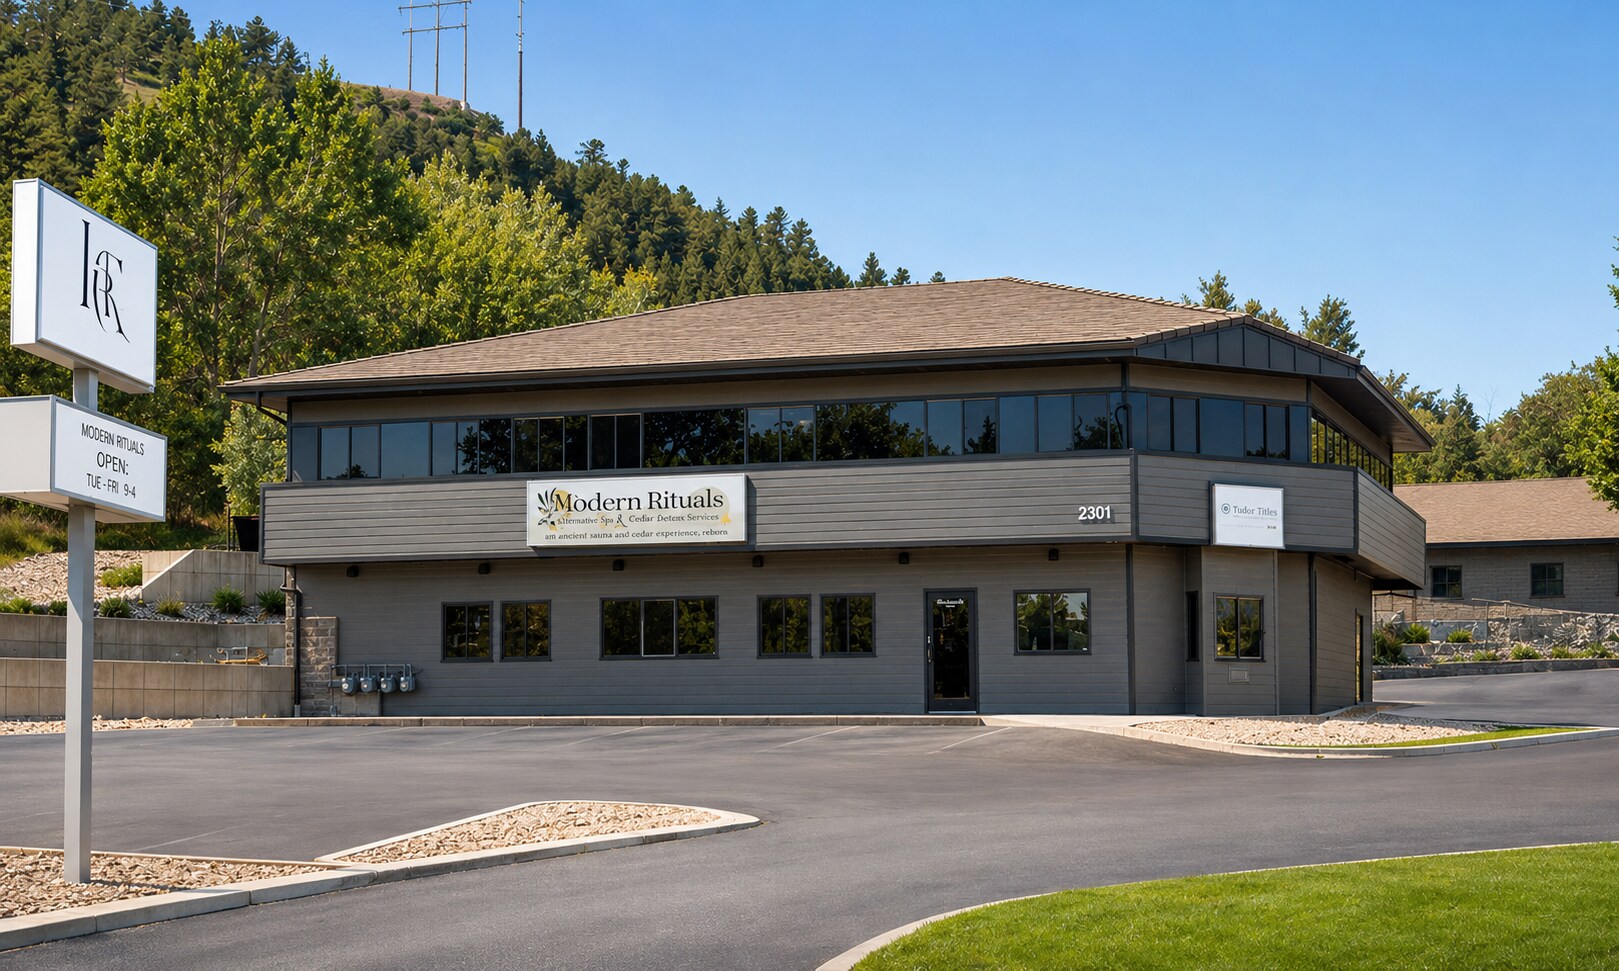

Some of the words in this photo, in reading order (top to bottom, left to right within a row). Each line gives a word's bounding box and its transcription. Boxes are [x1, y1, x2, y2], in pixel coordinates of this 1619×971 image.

[81, 422, 114, 446] MODERN
[116, 434, 144, 456] RITUALS
[96, 451, 129, 476] OPEN:
[86, 472, 101, 490] TUE
[107, 478, 118, 494] FRI
[123, 483, 136, 499] 9-4
[648, 488, 724, 510] Rituals
[1078, 505, 1111, 520] 2301
[1232, 505, 1255, 515] Tudor
[1257, 507, 1278, 516] Titles
[600, 515, 614, 526] Spa
[616, 513, 628, 528] &
[628, 514, 654, 523] Cedar
[687, 513, 720, 521] Services
[558, 531, 588, 540] ancient
[589, 531, 613, 539] sauna
[614, 530, 630, 538] and
[631, 530, 654, 538] cedar
[655, 530, 701, 539] experience,
